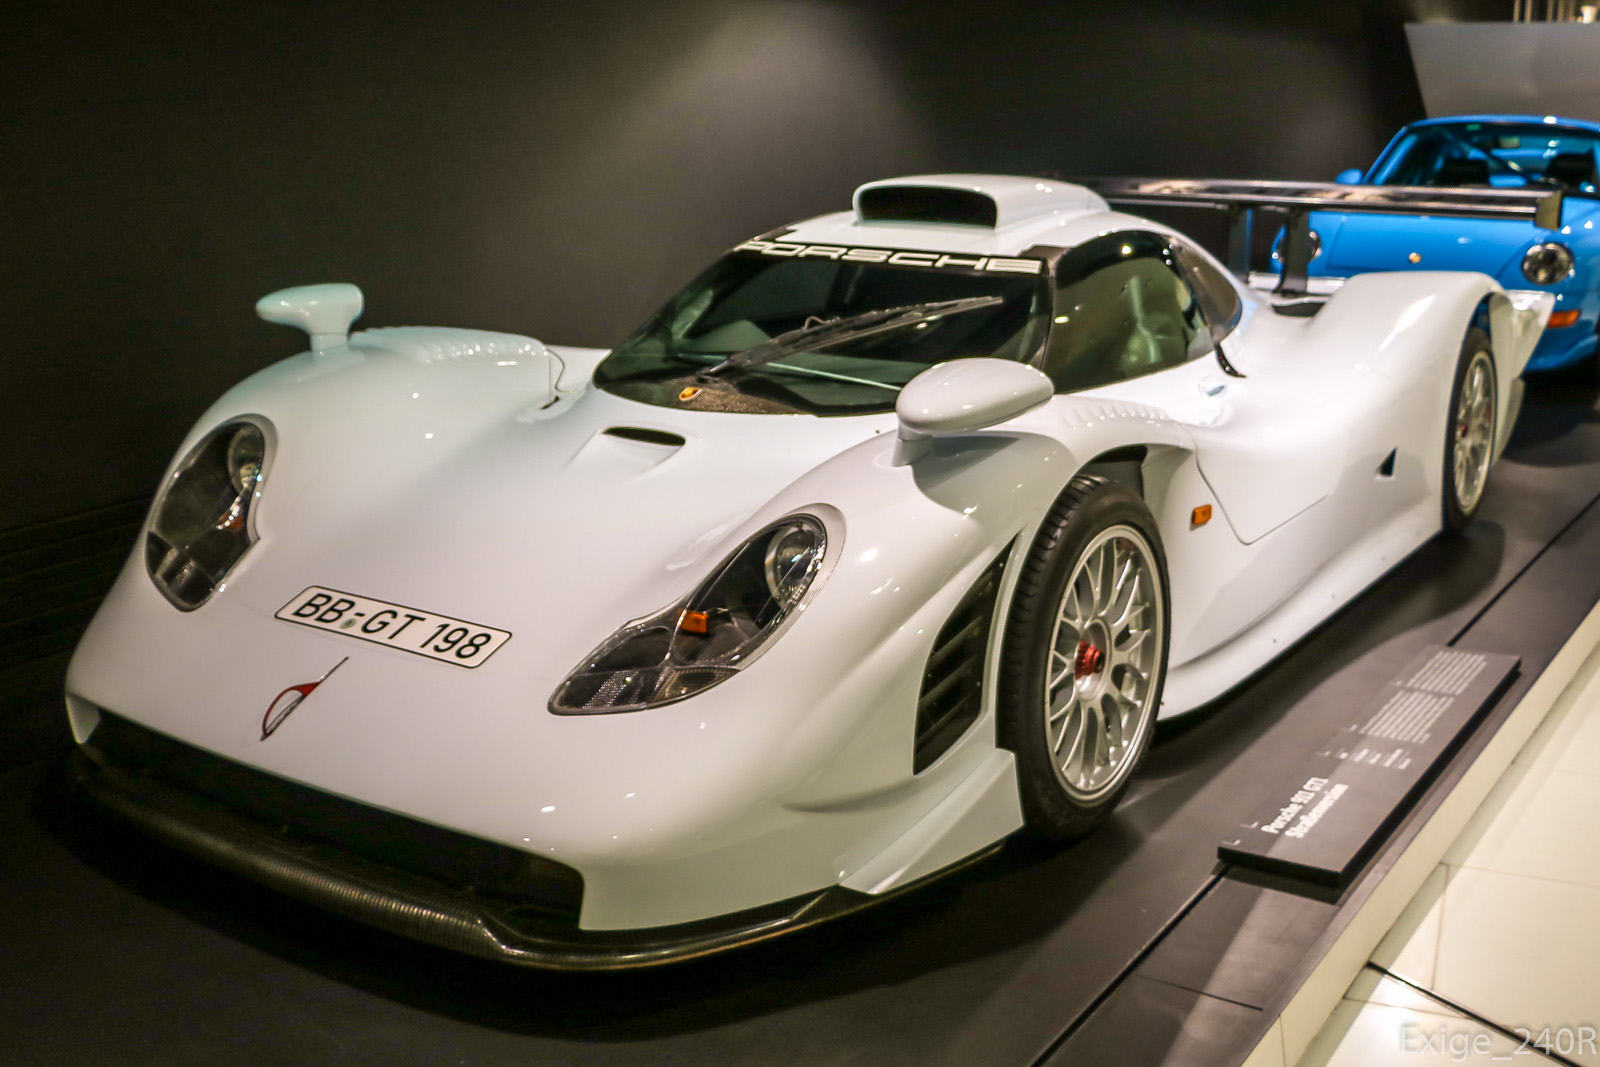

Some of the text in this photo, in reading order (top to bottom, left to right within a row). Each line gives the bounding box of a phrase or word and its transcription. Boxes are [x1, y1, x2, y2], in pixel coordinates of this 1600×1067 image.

[734, 241, 1042, 274] PORSCHE
[419, 623, 492, 659] 198
[1261, 776, 1329, 834] Porsche 911 GT1
